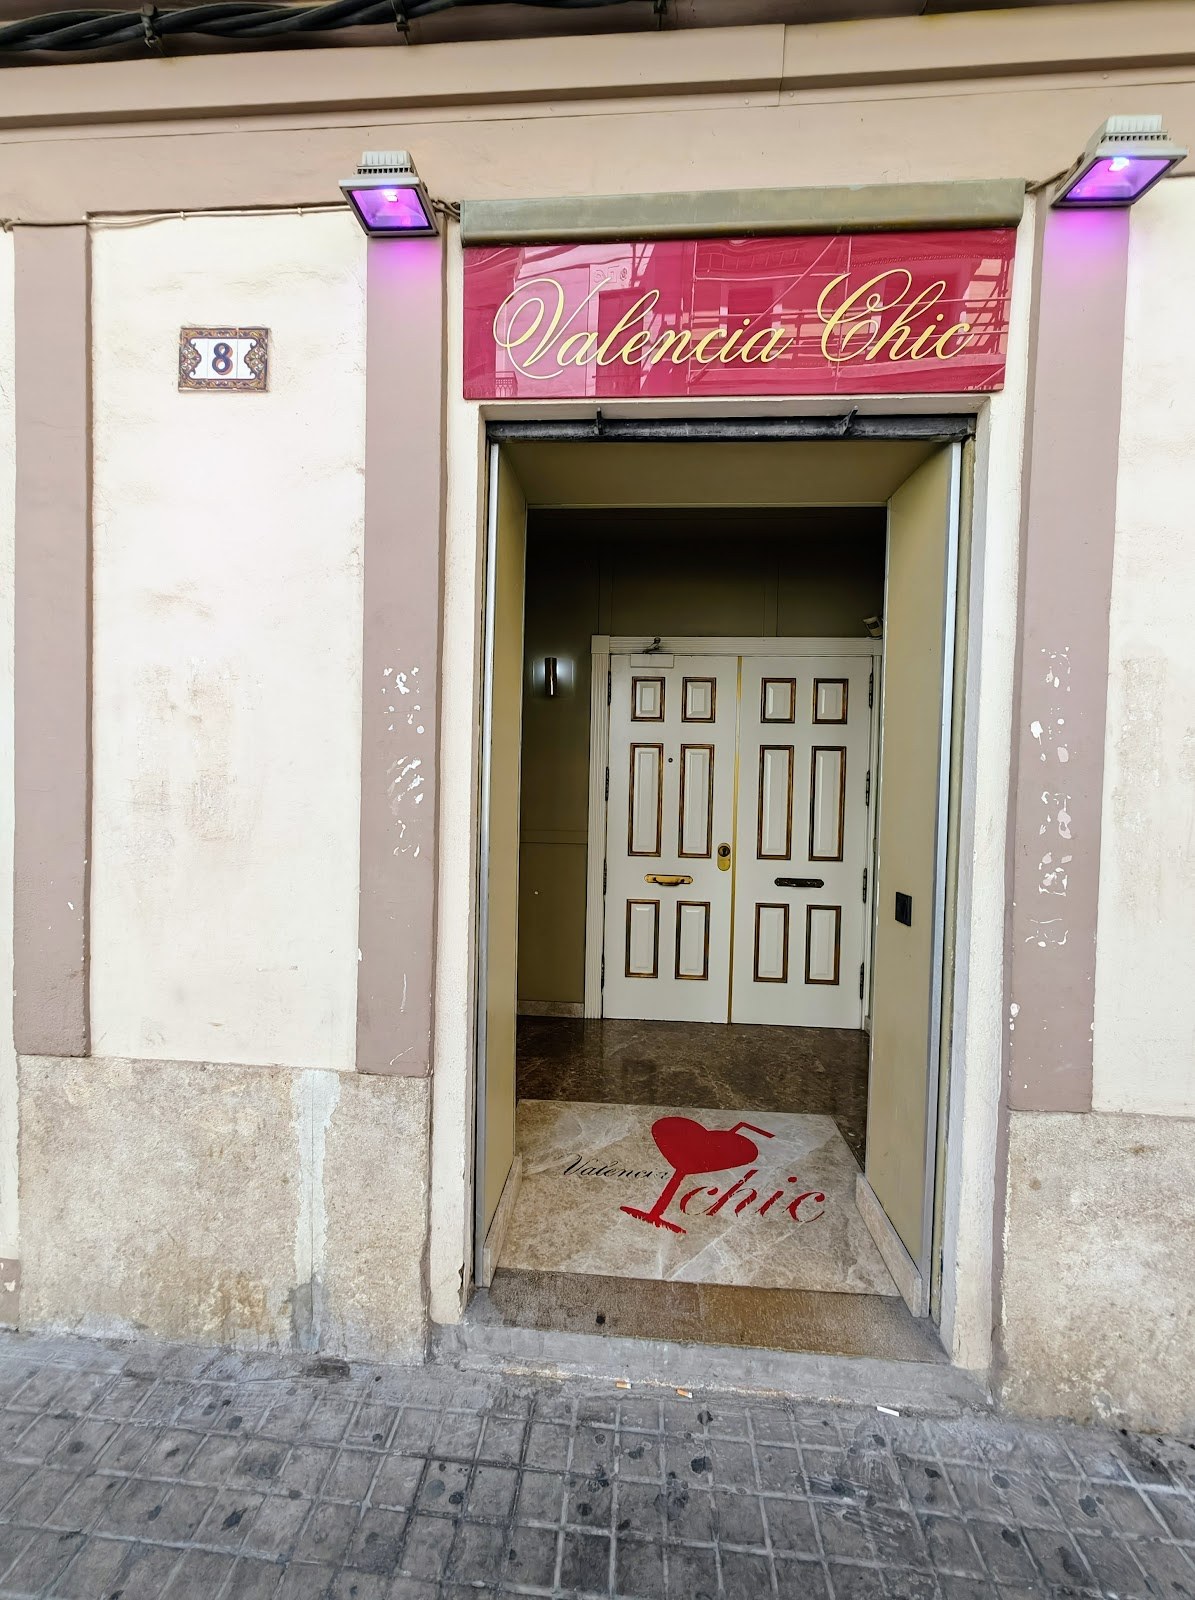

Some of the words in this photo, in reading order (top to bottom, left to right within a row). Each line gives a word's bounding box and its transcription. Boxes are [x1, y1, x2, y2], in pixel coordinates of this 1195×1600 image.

[492, 277, 794, 380] Valencia
[816, 268, 975, 362] Chic
[211, 342, 234, 376] 8
[679, 1169, 826, 1224] chic
